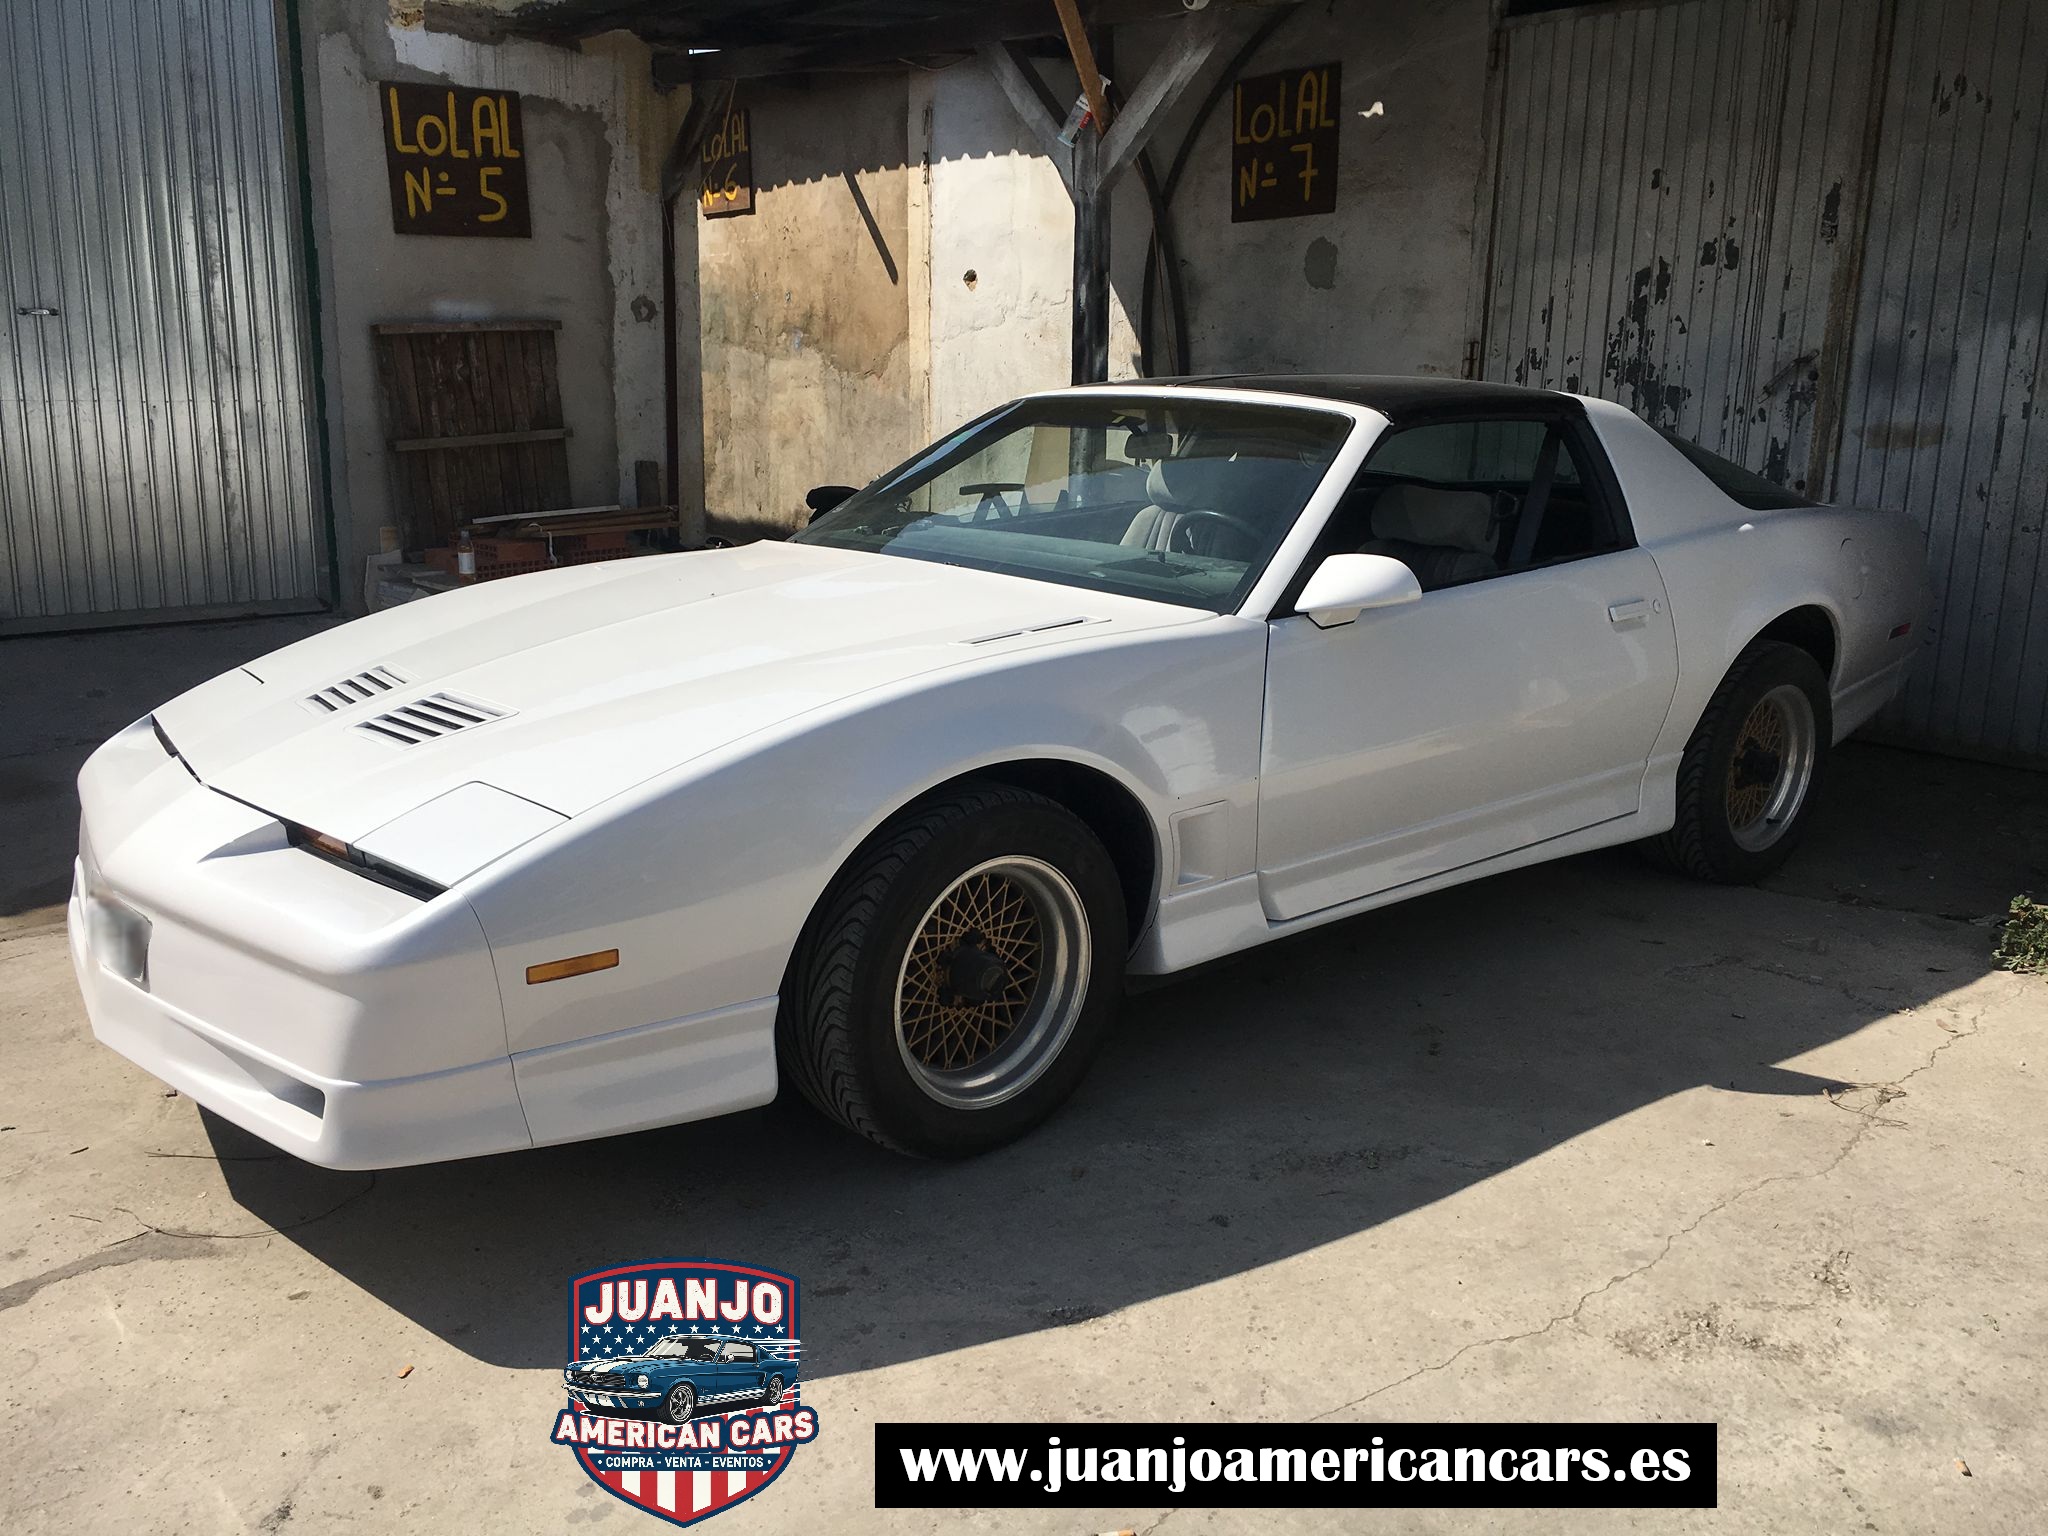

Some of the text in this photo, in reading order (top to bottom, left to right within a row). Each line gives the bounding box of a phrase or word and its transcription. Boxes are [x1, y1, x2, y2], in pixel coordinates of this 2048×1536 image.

[478, 167, 508, 222] 5
[724, 162, 738, 201] 6
[1290, 142, 1319, 202] 7
